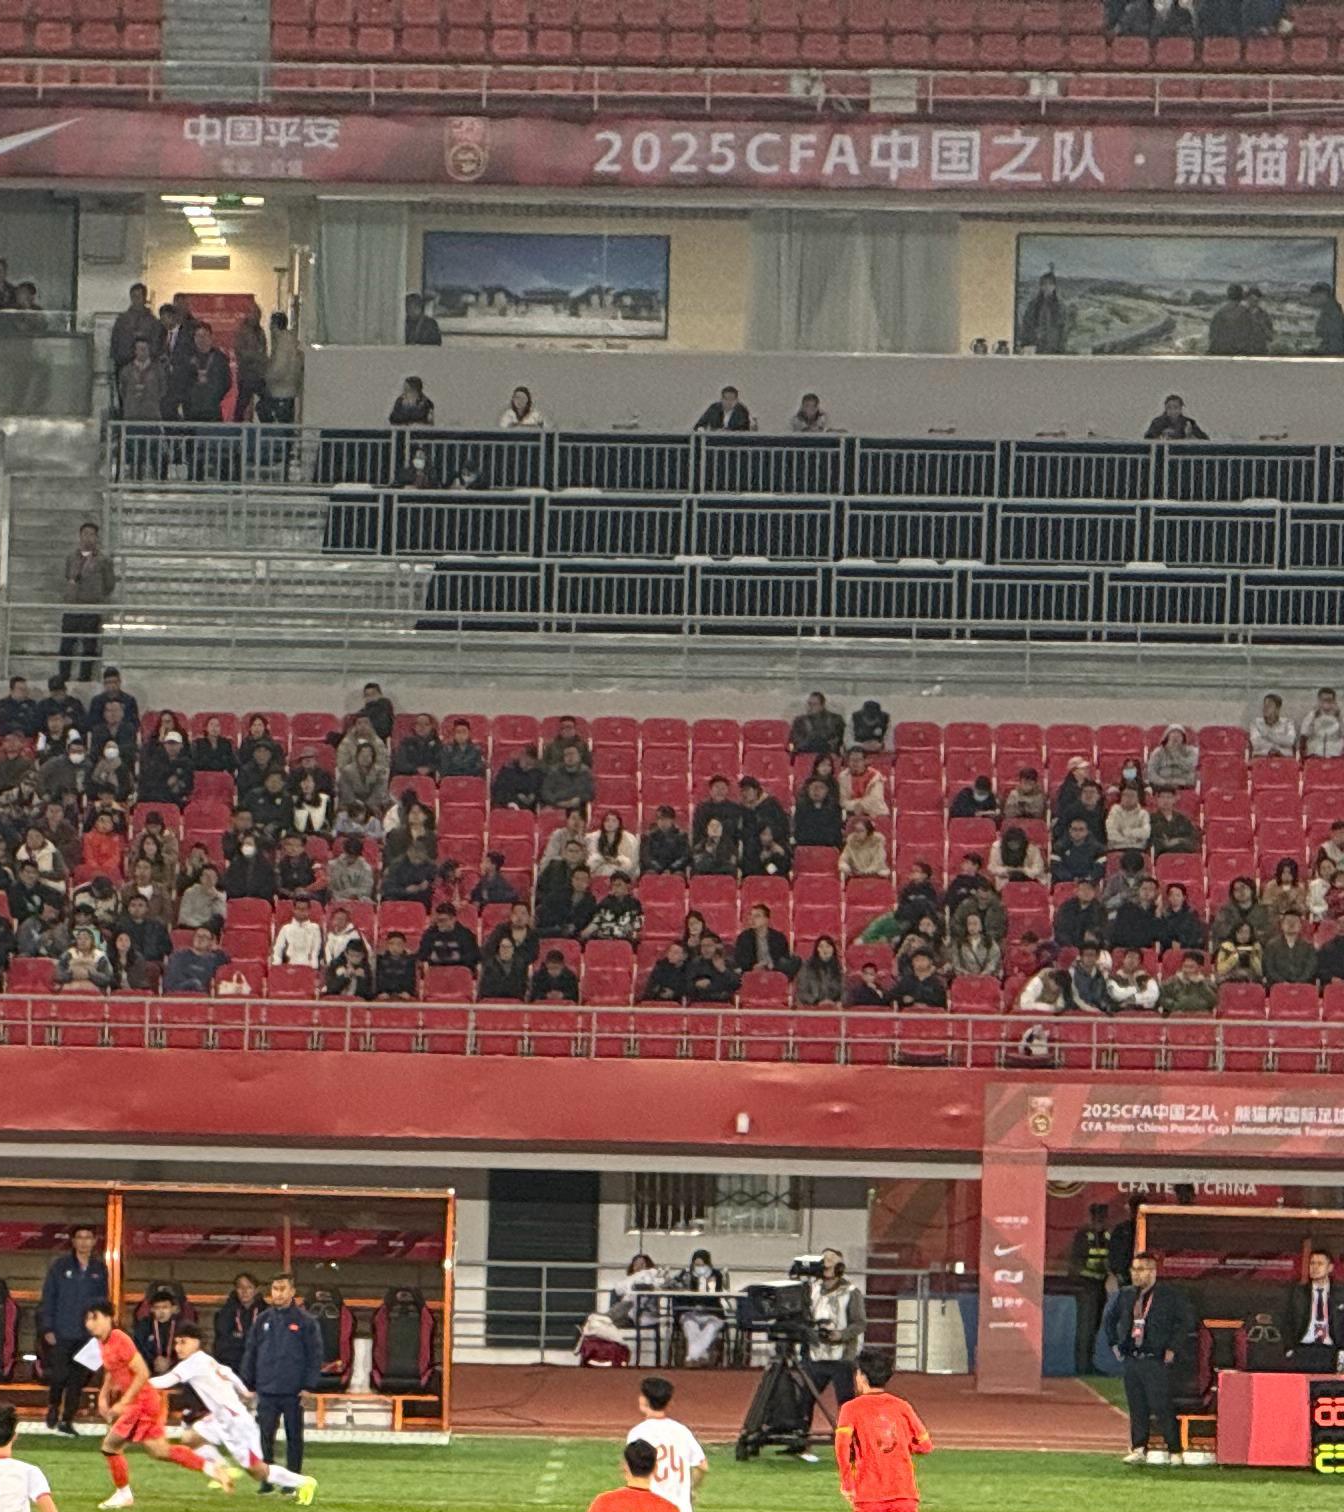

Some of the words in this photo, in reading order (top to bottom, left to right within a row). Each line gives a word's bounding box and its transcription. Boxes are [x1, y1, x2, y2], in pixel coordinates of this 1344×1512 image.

[183, 114, 341, 150] 中国平安
[1080, 1121, 1103, 1132] CFA
[1207, 1124, 1229, 1136] Cup
[1117, 1181, 1150, 1193] CFA
[1204, 1182, 1258, 1196] CHINA
